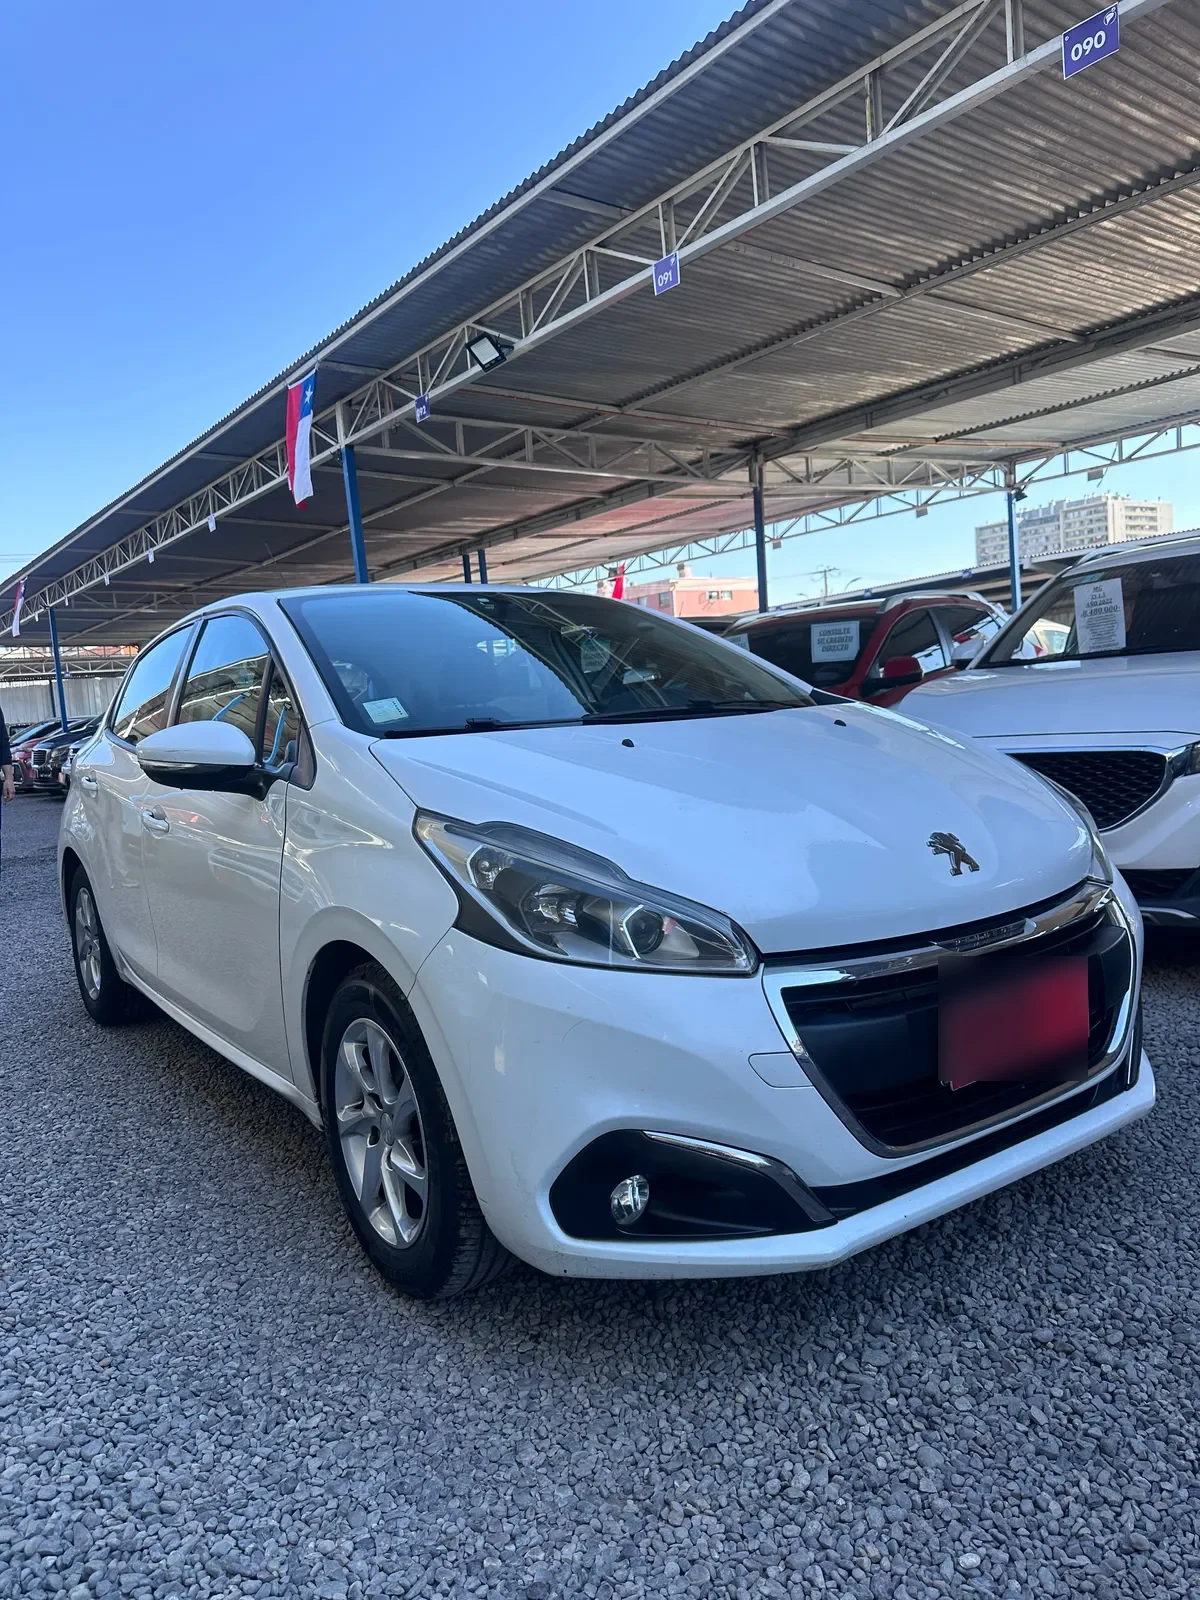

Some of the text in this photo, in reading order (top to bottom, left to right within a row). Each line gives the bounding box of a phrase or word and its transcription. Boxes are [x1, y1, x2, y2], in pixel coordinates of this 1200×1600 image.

[1070, 30, 1106, 61] 090
[657, 269, 673, 287] 091
[819, 628, 851, 636] CONSULTE
[821, 644, 849, 652] DIRECTO
